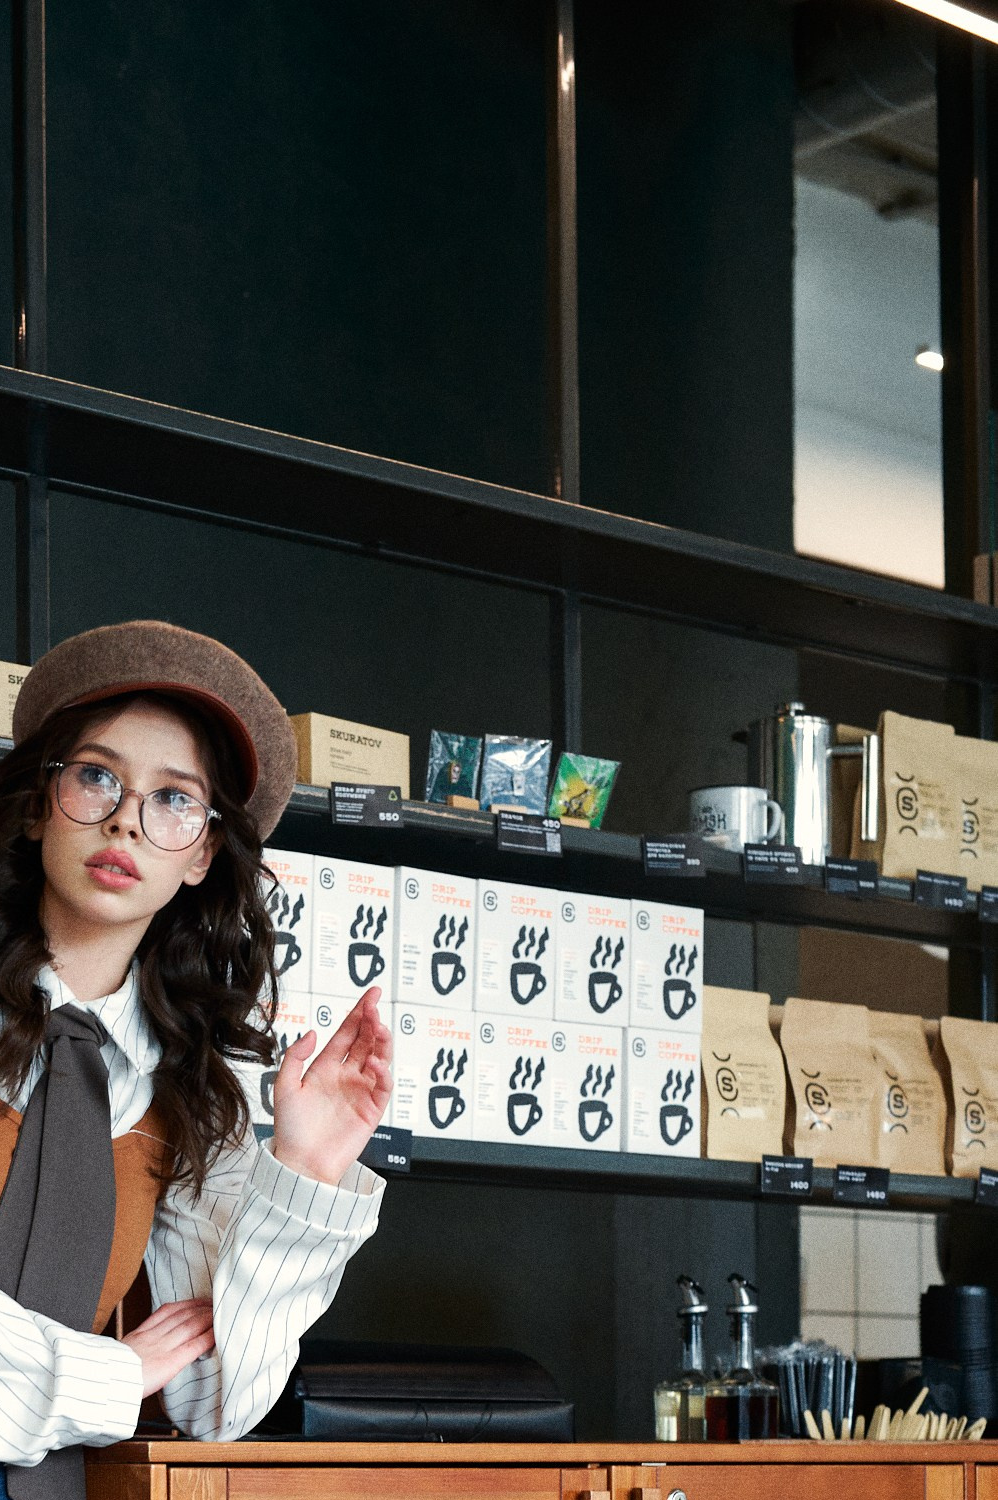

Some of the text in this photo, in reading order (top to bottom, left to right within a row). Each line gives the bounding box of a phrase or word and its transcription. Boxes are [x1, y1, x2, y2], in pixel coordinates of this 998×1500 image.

[330, 729, 382, 748] SKURATOV
[379, 812, 400, 822] 550
[348, 873, 374, 884] DRIP
[348, 884, 390, 898] COFFEE
[432, 884, 456, 893] DRIP
[432, 894, 471, 908] COFFEE
[511, 896, 536, 905] DRIP
[511, 906, 552, 918] COFFEE
[588, 906, 612, 915] DRIP
[588, 917, 627, 929] COFFEE
[662, 915, 686, 925] DRIP
[662, 925, 699, 936] COFFEE
[429, 1018, 455, 1027] DRIP
[429, 1028, 471, 1041] COFFEE
[507, 1026, 533, 1037] DRIP
[507, 1037, 548, 1049] COFFEE
[579, 1035, 602, 1044] DRIP
[658, 1041, 682, 1050] DRIP
[579, 1046, 618, 1057] COFFEE
[658, 1052, 697, 1062] COFFEE
[387, 1154, 407, 1165] 550
